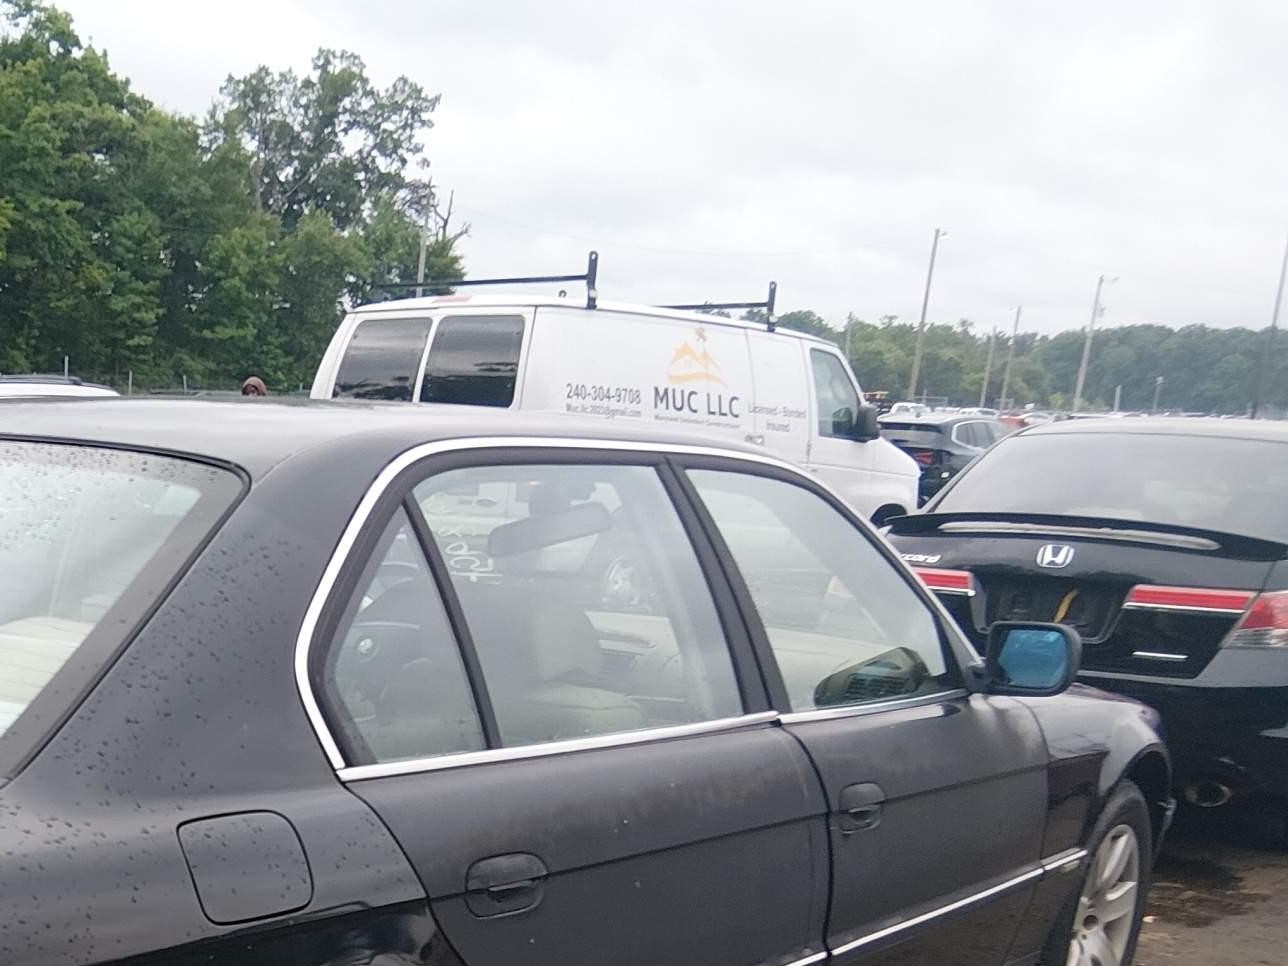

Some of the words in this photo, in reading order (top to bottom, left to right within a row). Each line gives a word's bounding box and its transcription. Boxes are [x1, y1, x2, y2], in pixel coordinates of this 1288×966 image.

[566, 383, 642, 406] 240-304-9708
[654, 386, 698, 414] MUC
[707, 391, 740, 419] LLC
[900, 554, 941, 563] ccord
